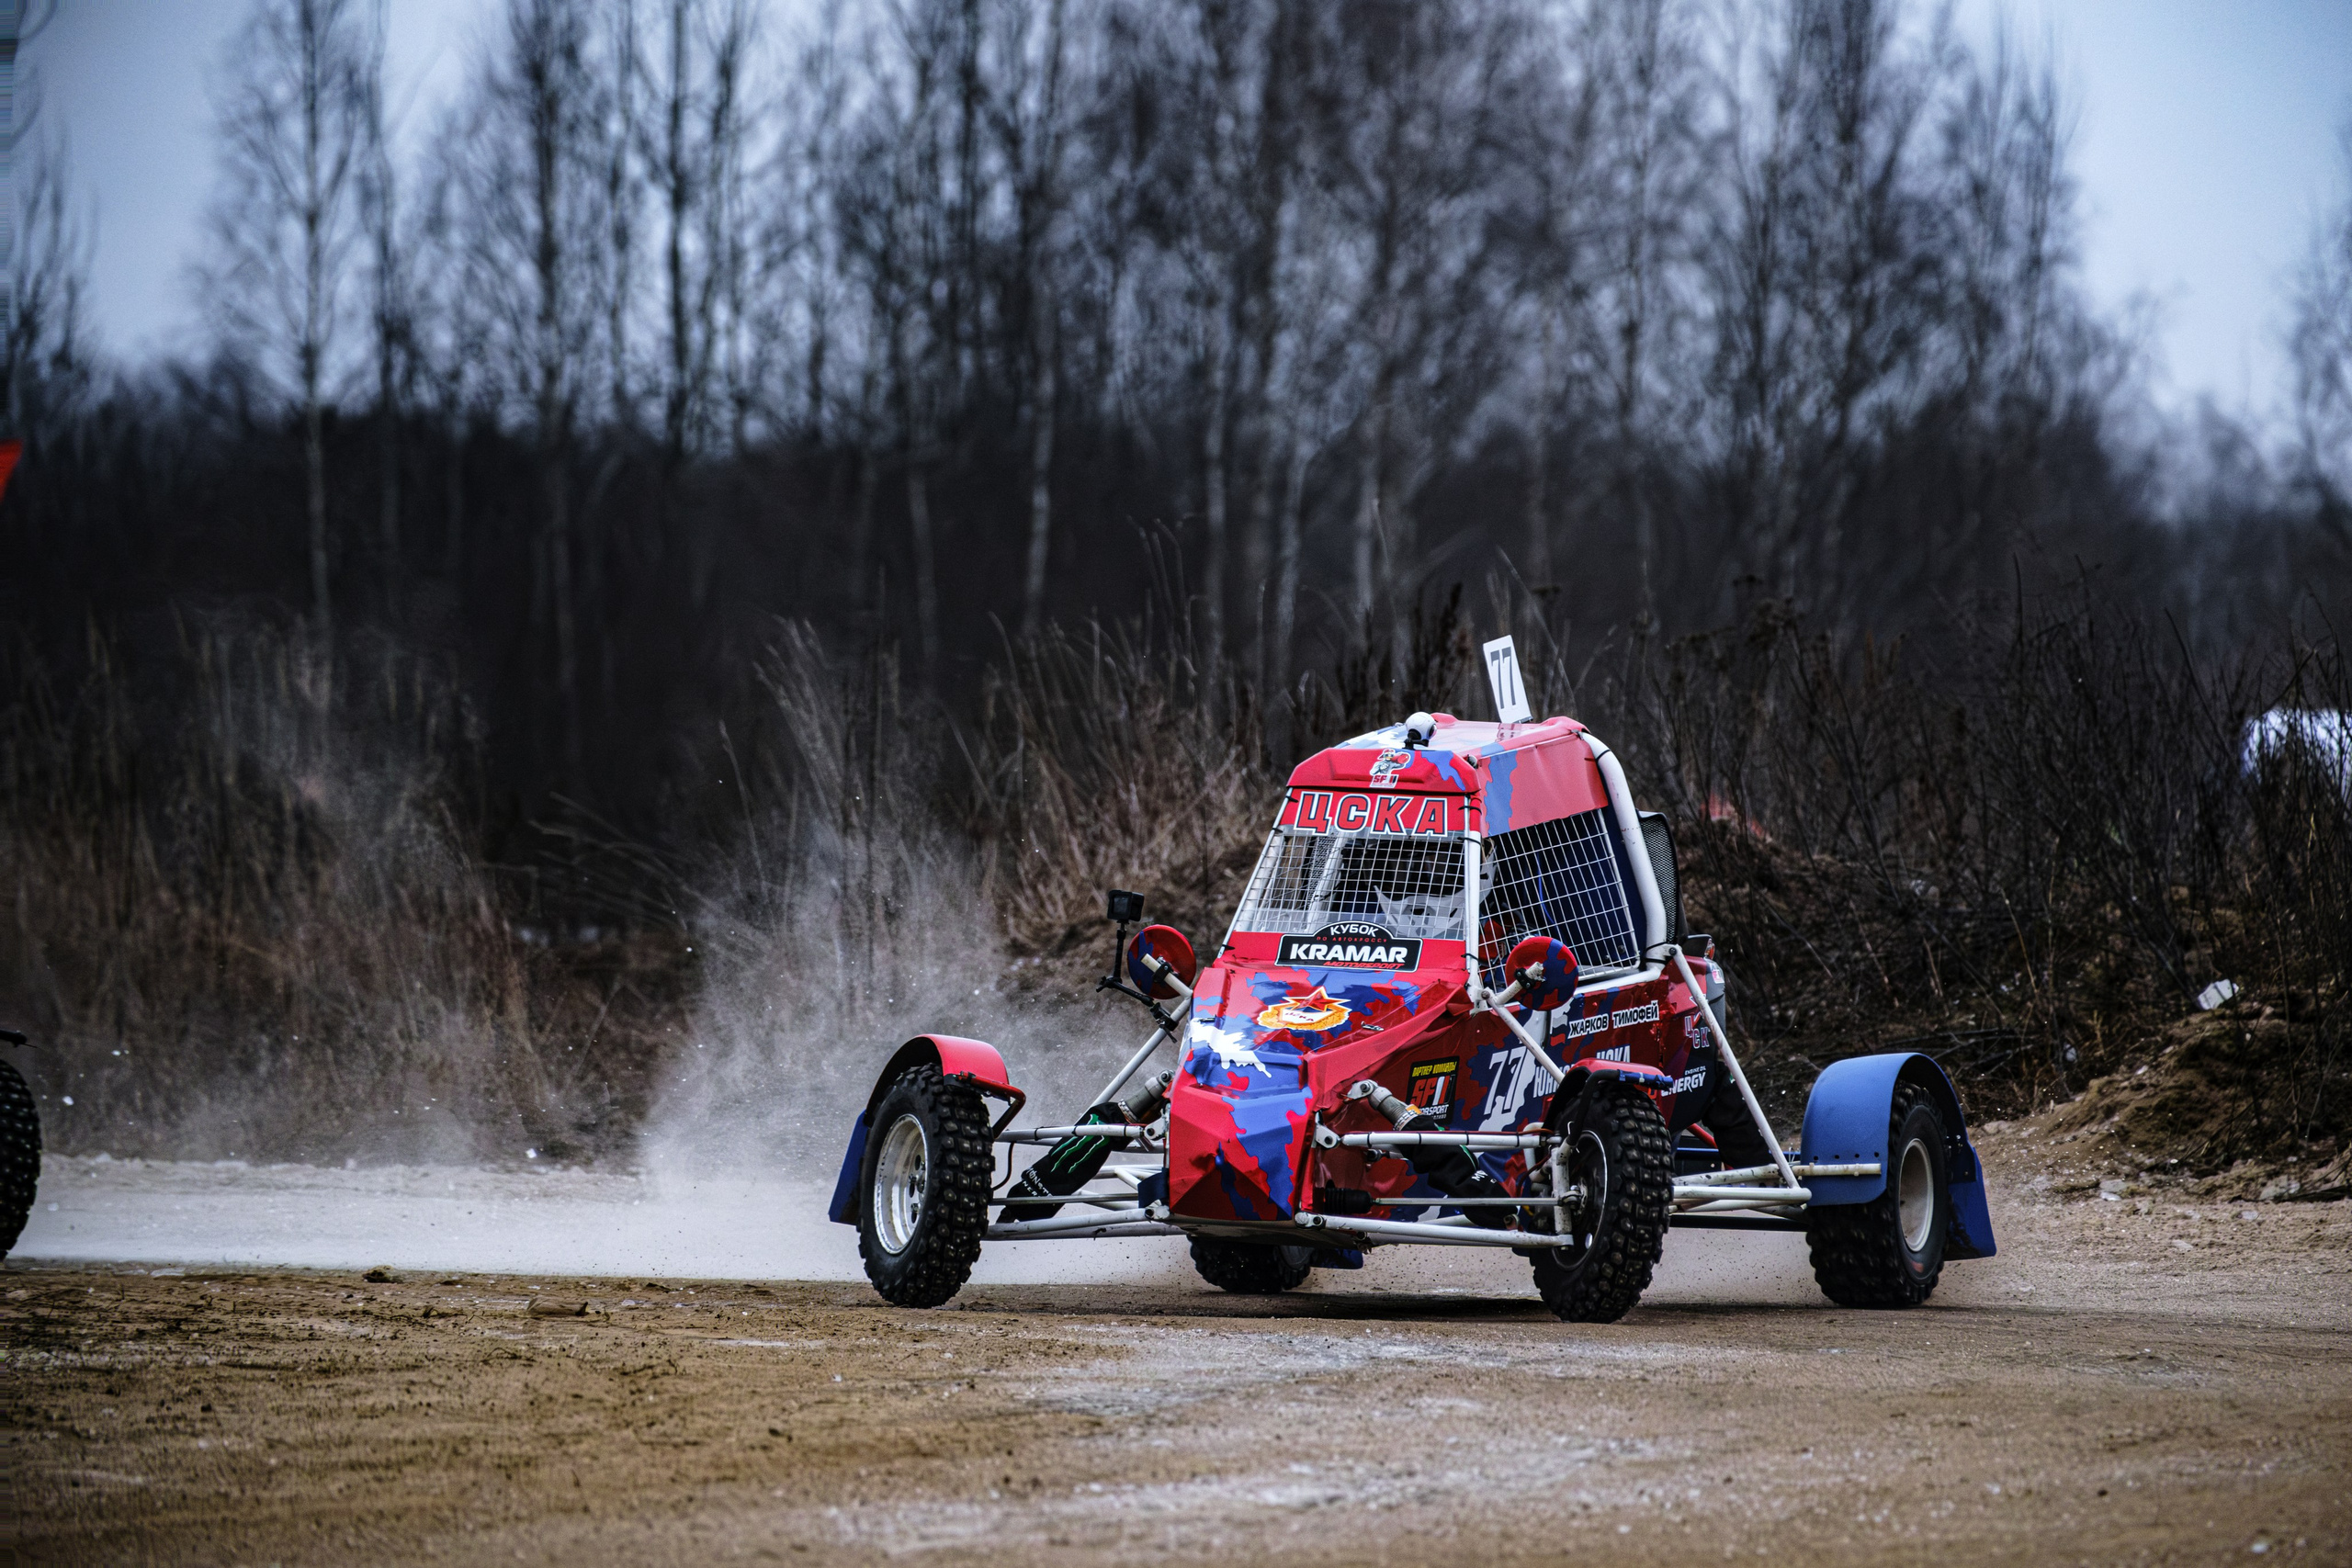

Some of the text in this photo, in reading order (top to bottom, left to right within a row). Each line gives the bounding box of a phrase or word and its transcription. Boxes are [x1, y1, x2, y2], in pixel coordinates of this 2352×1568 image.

[1490, 647, 1516, 709] 77
[1294, 791, 1448, 837] ЦСКА
[1330, 924, 1378, 937] КУБОК
[1290, 943, 1408, 963] KRAMAR
[1323, 961, 1405, 969] MOTORSPORT
[1570, 1002, 1657, 1036] ЖАРКОВ ТИМОФЕЙ
[1684, 1015, 1711, 1049] ЦСК
[1483, 1045, 1527, 1115] 77
[1420, 1104, 1449, 1115] ORSPORT
